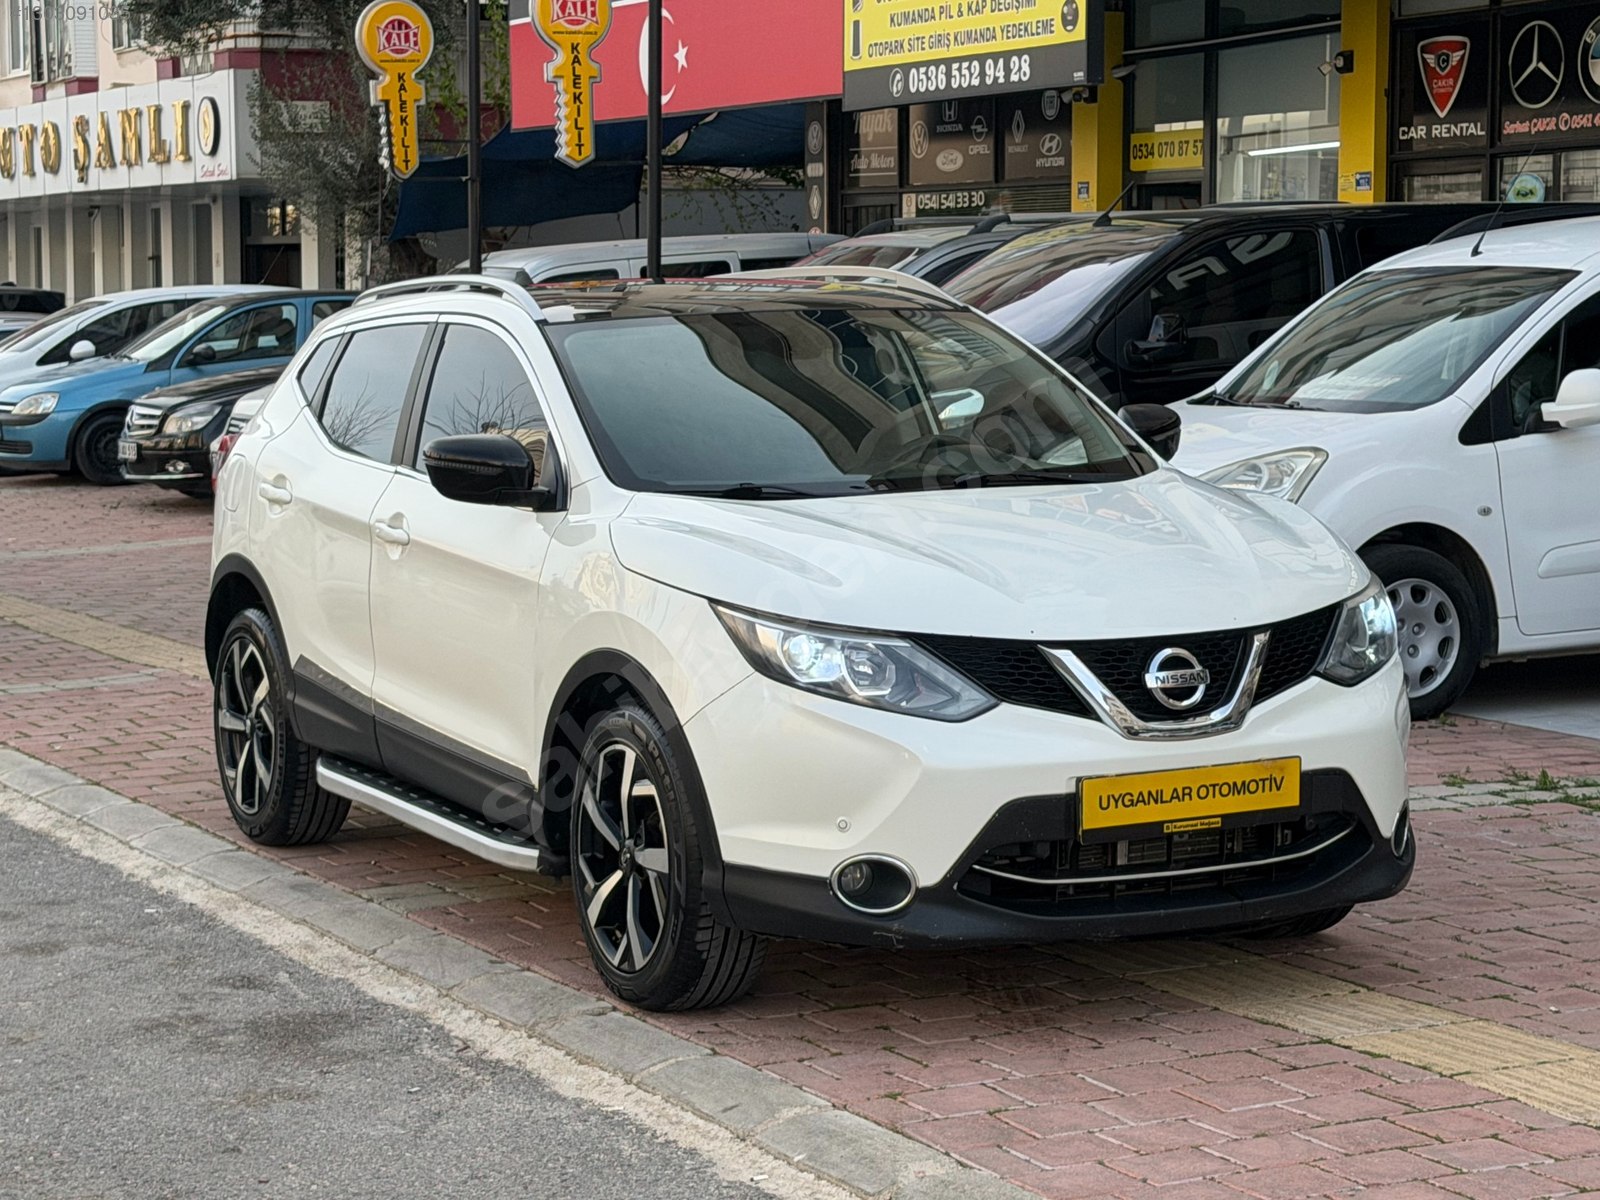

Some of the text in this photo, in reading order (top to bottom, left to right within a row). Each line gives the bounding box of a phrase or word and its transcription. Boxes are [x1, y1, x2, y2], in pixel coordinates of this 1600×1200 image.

[552, 0, 599, 25] KALE
[889, 8, 936, 28] KUMANDA
[938, 2, 954, 20] PİL
[956, 3, 964, 18] &
[967, 0, 987, 16] KAP
[377, 28, 419, 52] KALE
[868, 18, 1055, 58] OTOPARK SİTE GİRİŞ KUMANDA YEDEKLEME
[908, 54, 1030, 93] 0536 552 94 28
[936, 123, 963, 133] HONDA
[1399, 122, 1486, 140] CAR RENTAL
[72, 99, 193, 184] ŞANLI
[968, 144, 990, 155] OPEL
[1132, 138, 1203, 160] 0534 070 87 57
[870, 153, 894, 168] Motors
[1036, 157, 1065, 168] HYUNDAI
[917, 190, 985, 210] 0541 541 33 30
[1155, 670, 1208, 686] NISSAN
[1099, 773, 1285, 811] UYGANLAR OTOMOTİV
